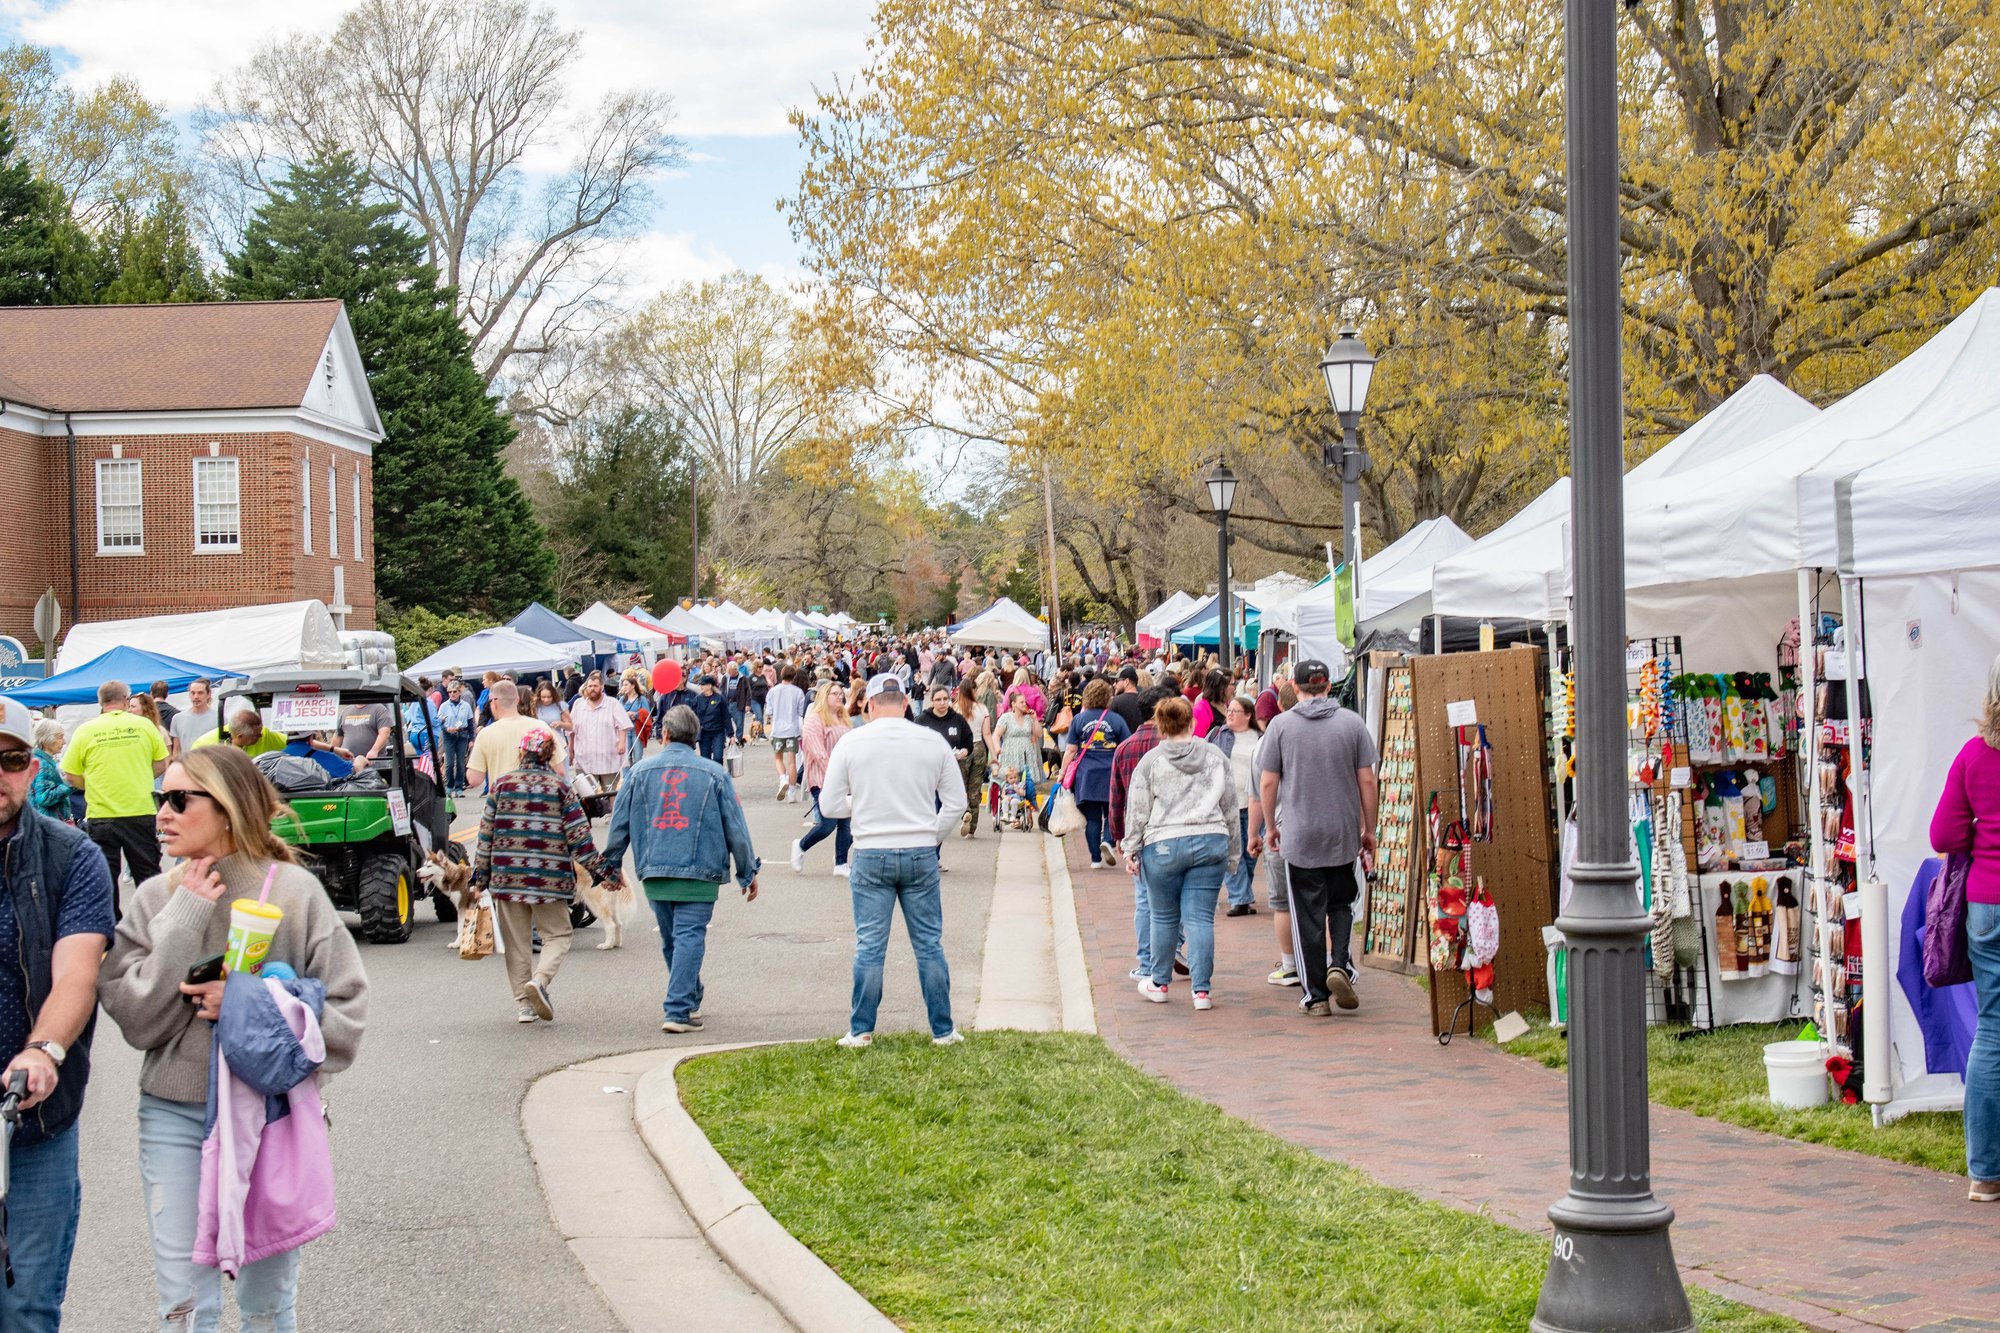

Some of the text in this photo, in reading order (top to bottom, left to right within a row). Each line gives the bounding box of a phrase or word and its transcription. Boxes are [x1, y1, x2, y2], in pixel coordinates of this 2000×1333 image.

[294, 699, 333, 708] MARCH
[294, 706, 336, 717] JESUS
[1553, 1233, 1573, 1261] 90
